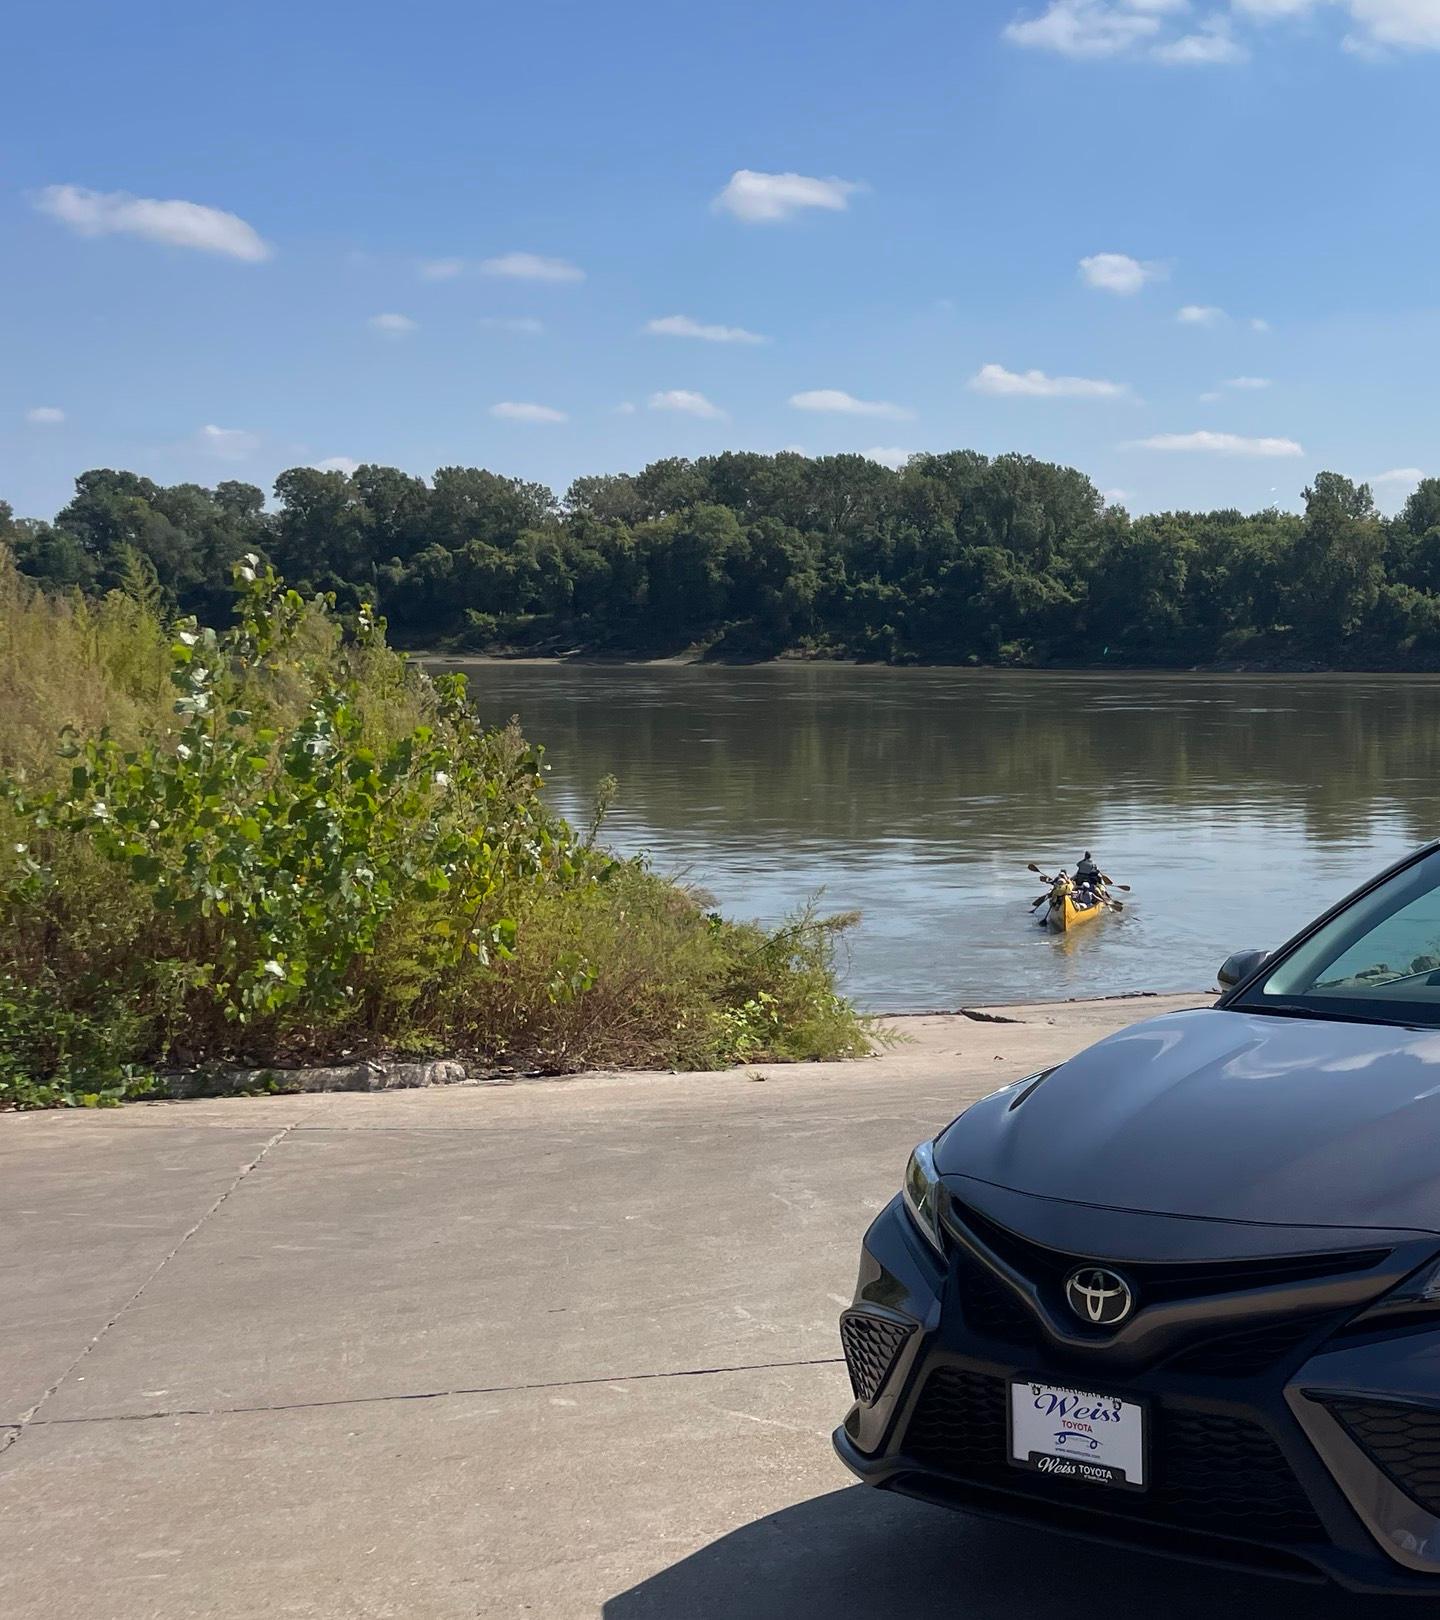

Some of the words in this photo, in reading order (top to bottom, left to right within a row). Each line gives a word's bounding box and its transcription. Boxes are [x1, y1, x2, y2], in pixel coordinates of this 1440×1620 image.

[1034, 1393, 1121, 1422] Weiss
[1062, 1420, 1093, 1433] TOYOTA
[1038, 1457, 1076, 1474] Weiss
[1079, 1464, 1113, 1480] TOYOTA
